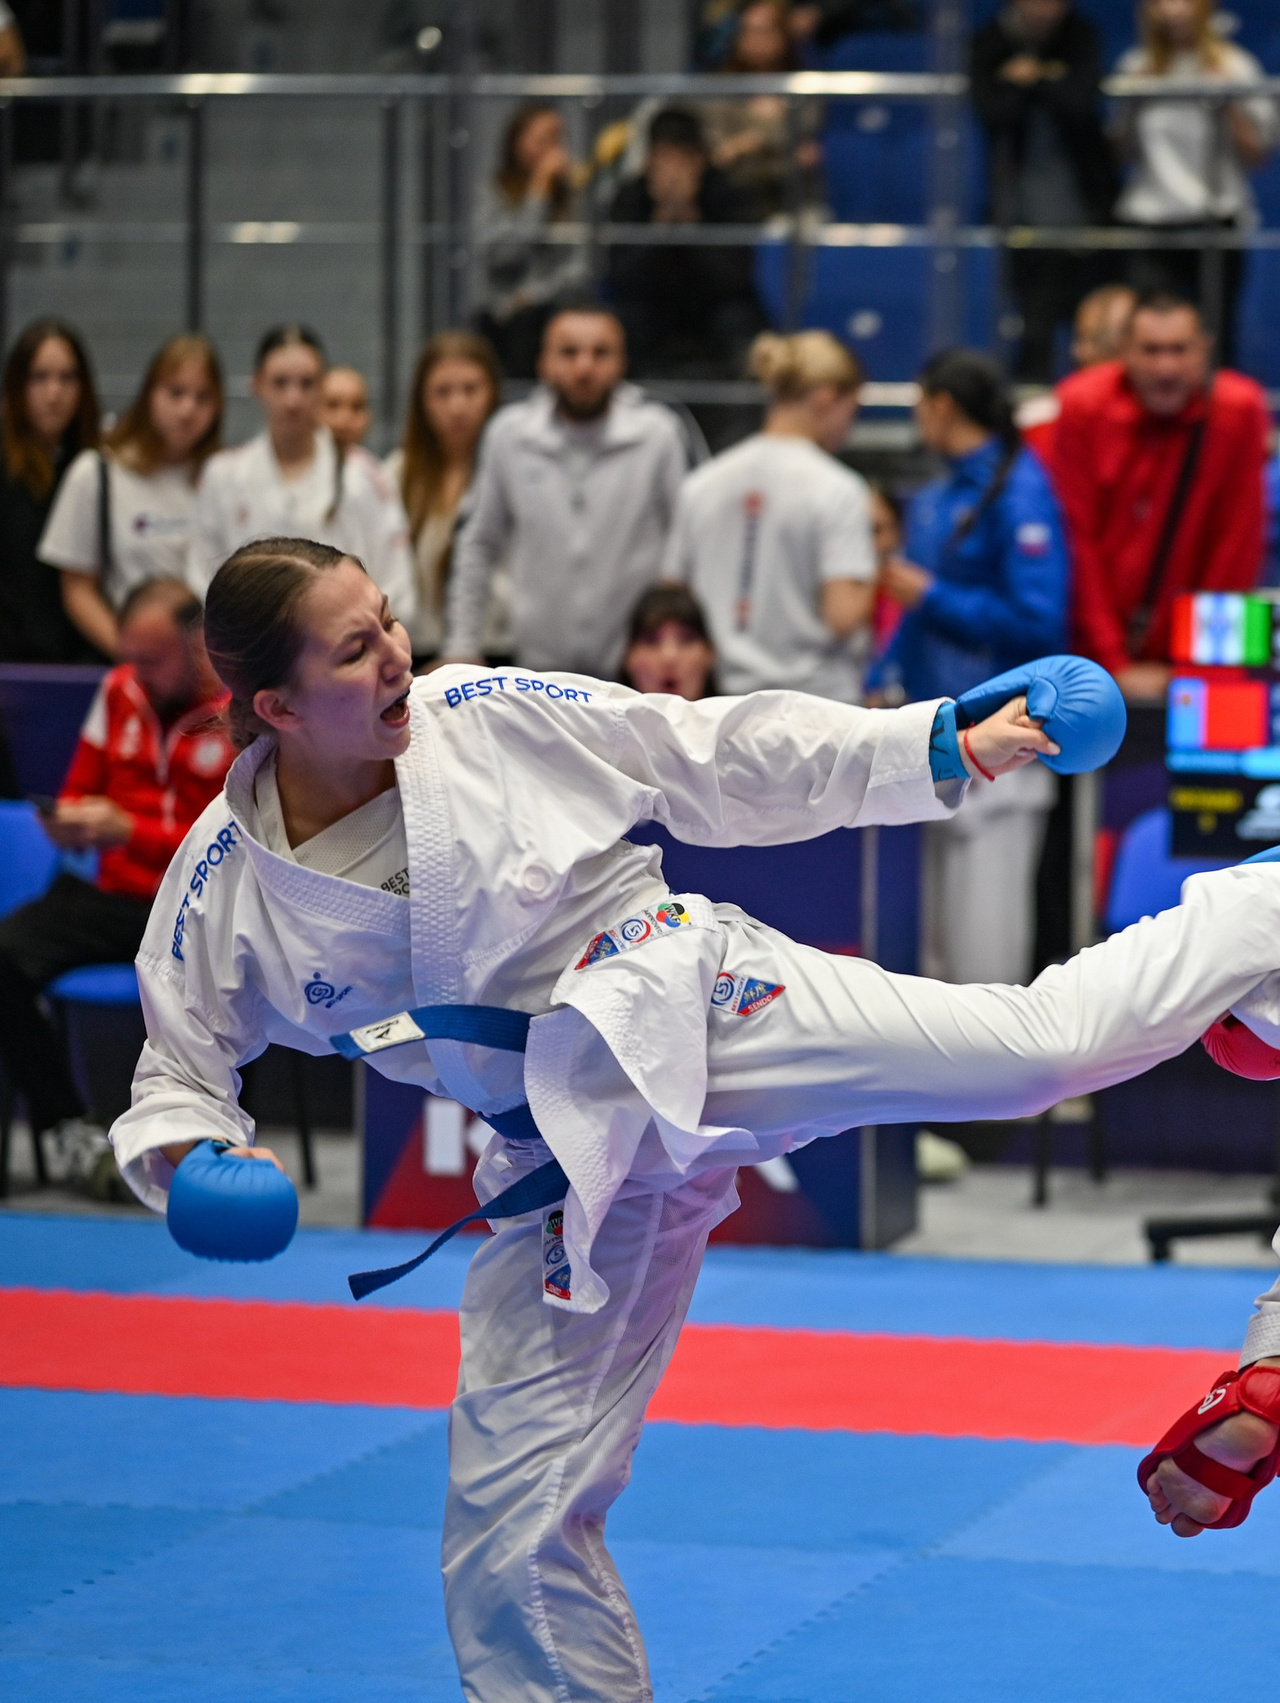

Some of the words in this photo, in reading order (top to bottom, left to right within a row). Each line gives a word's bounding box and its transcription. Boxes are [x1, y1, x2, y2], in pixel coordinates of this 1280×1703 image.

[444, 677, 507, 708] BEST
[514, 678, 592, 703] SPORT
[190, 821, 243, 898] SPORT
[381, 867, 409, 892] BEST
[747, 994, 773, 1012] SENDO
